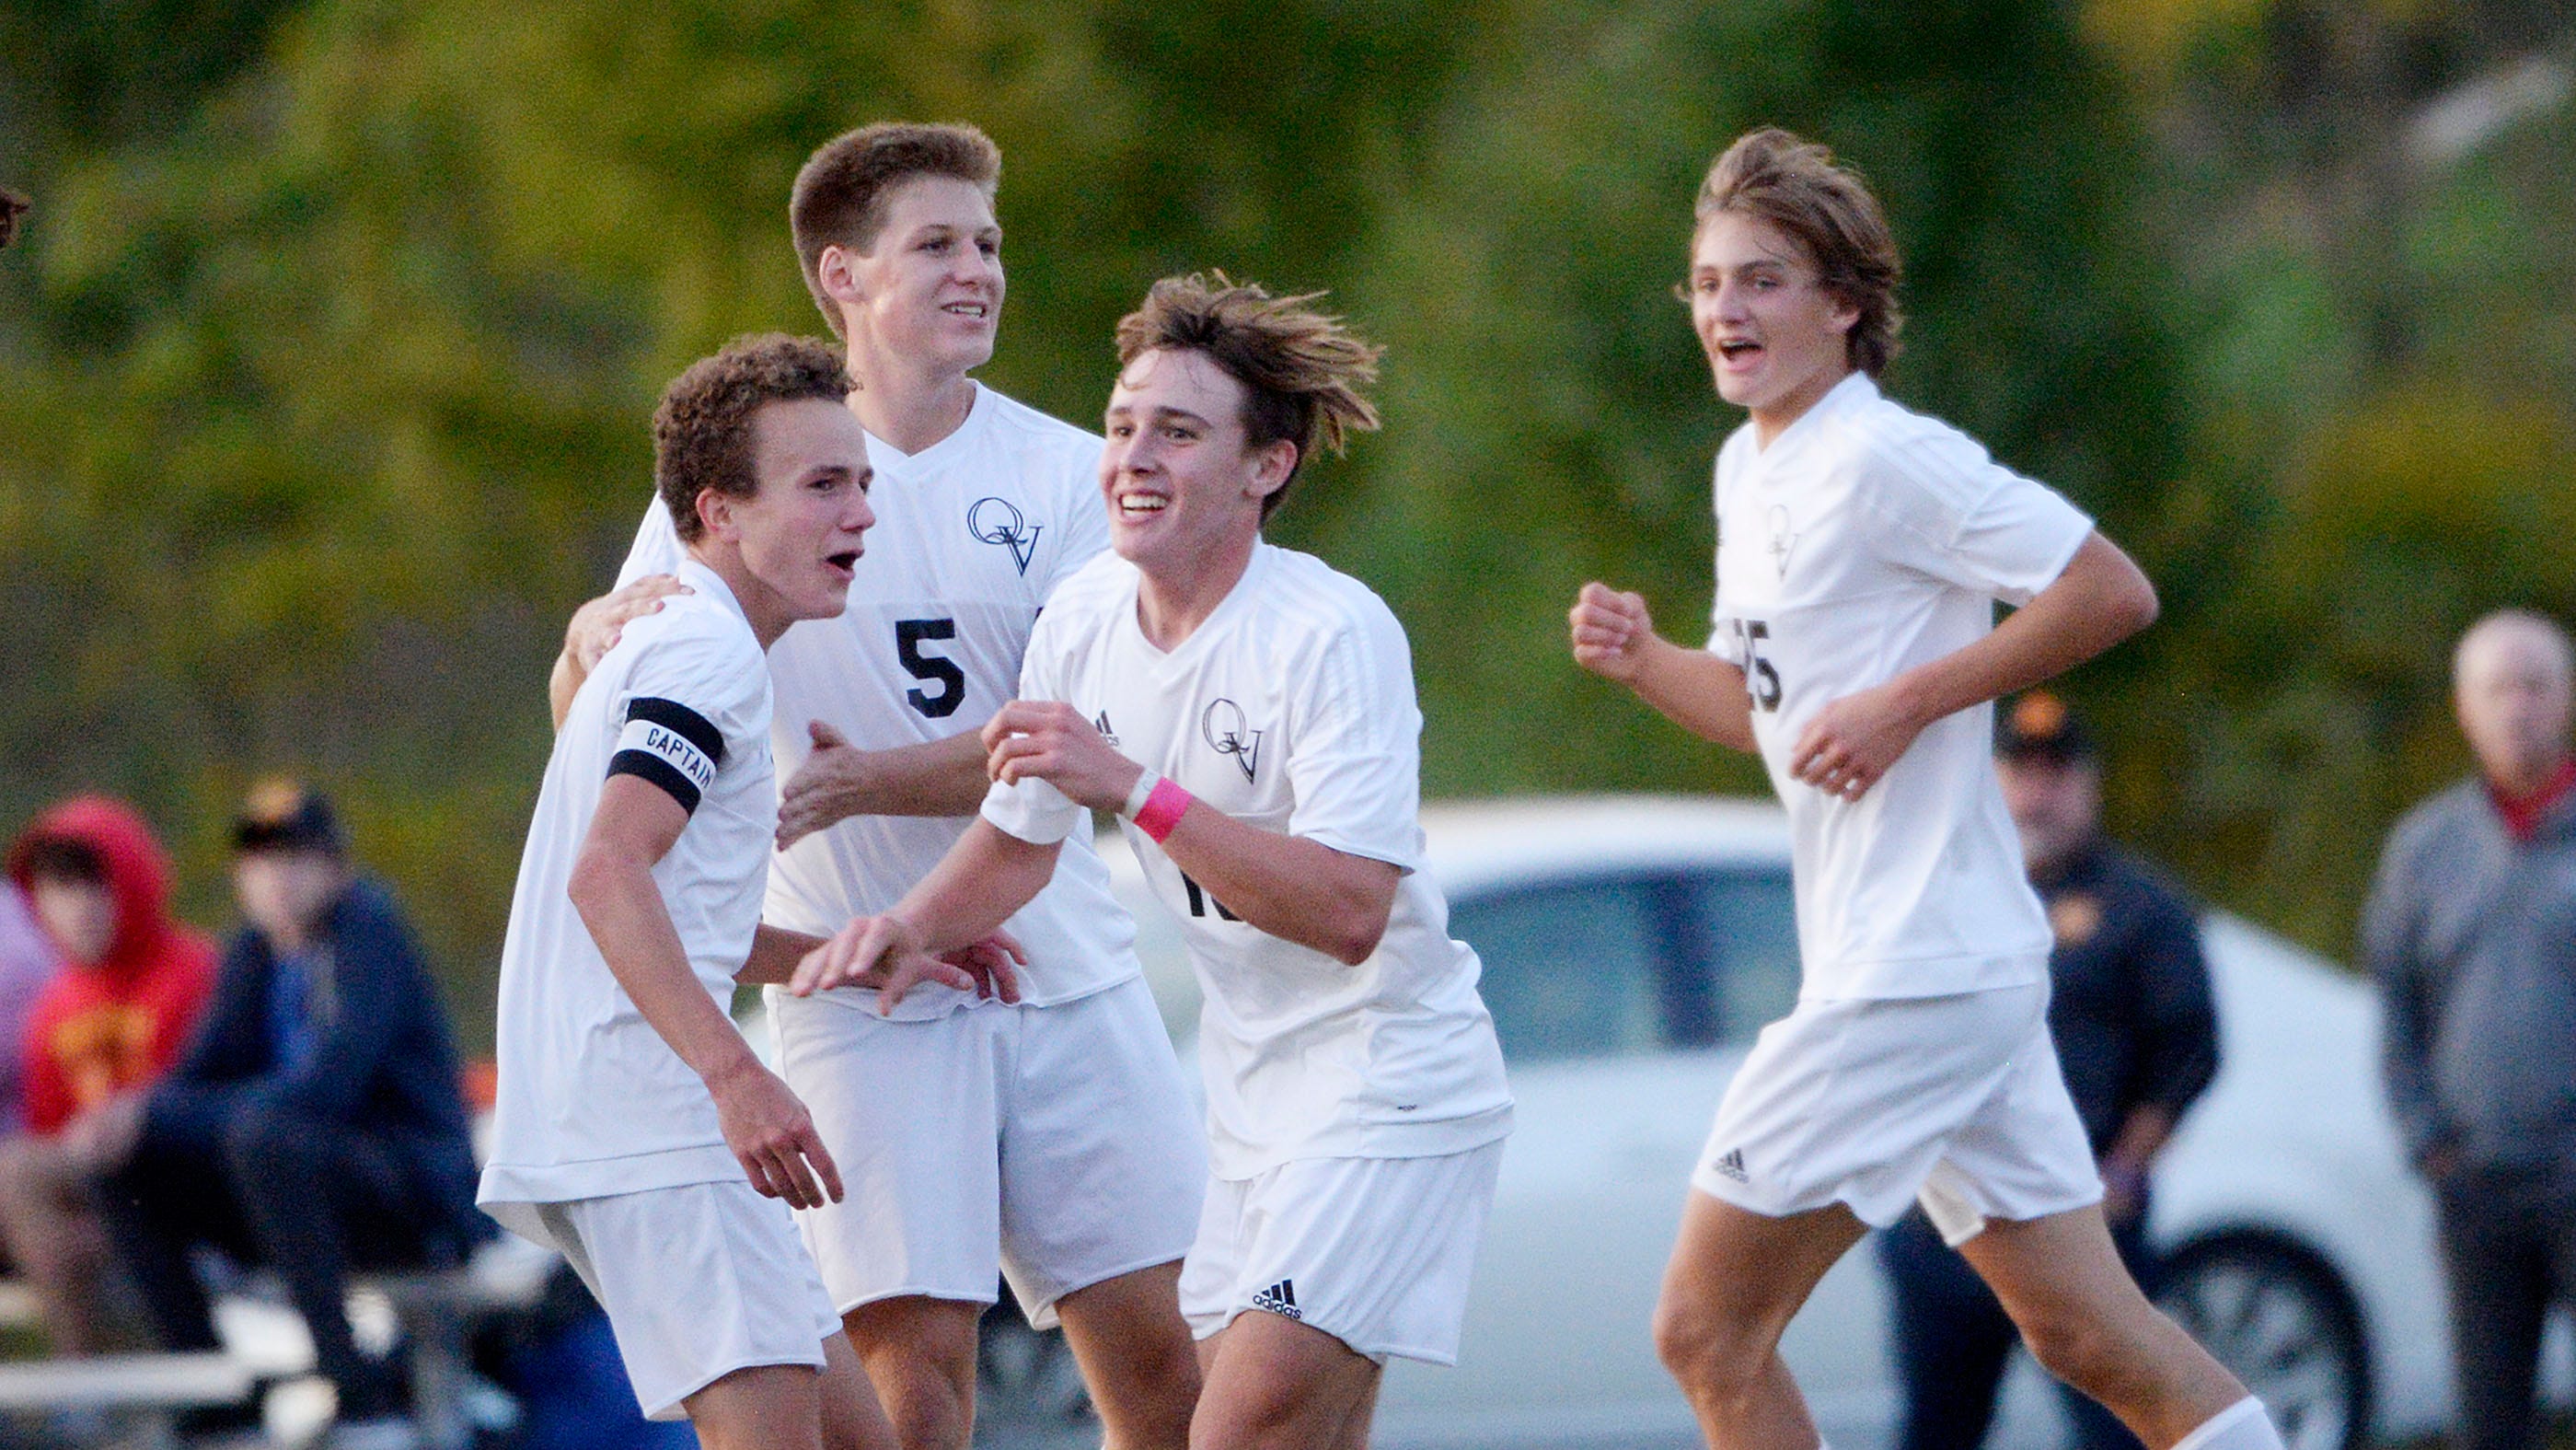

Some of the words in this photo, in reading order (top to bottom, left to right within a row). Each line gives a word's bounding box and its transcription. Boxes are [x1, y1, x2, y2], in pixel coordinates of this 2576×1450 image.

[895, 618, 965, 717] 5
[1203, 699, 1264, 784] QV
[1253, 1295, 1302, 1319] adidas
